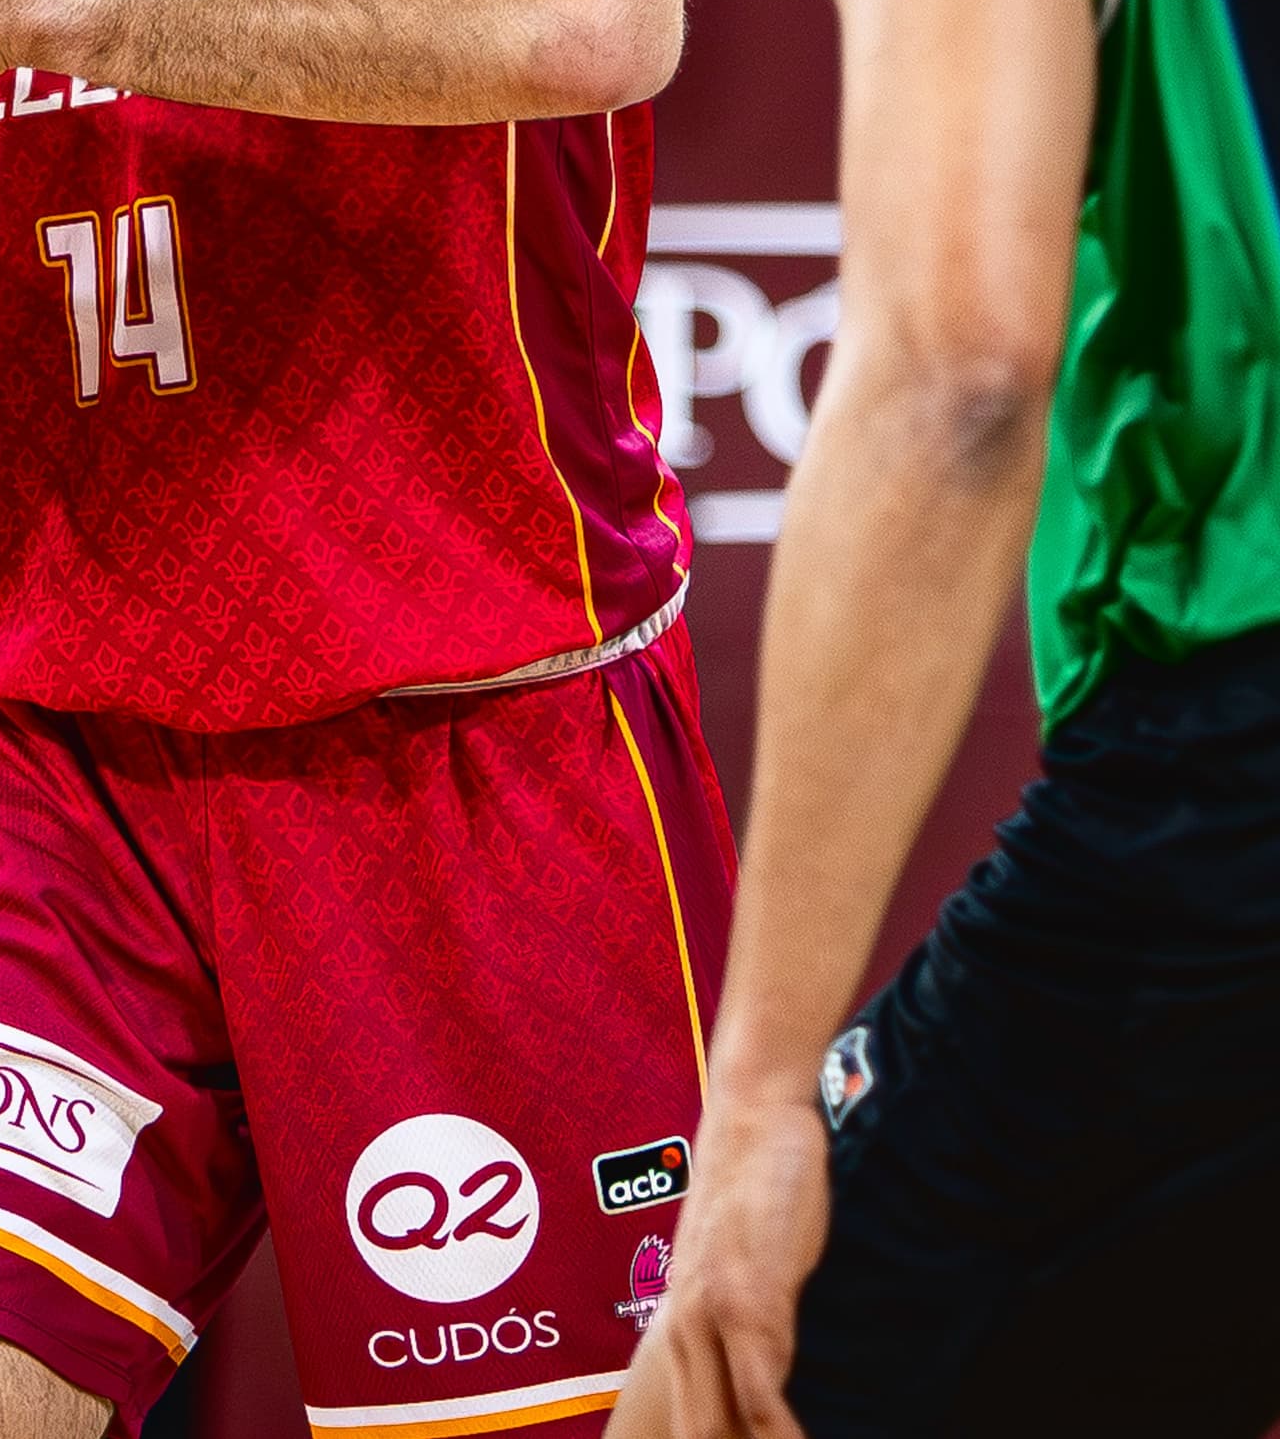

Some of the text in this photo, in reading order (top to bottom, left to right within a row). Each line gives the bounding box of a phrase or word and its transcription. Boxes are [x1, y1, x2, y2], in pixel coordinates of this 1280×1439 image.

[36, 194, 198, 409] 14
[358, 1160, 530, 1251] Q2
[608, 1168, 673, 1204] acb
[368, 1307, 560, 1368] CUDÓS
